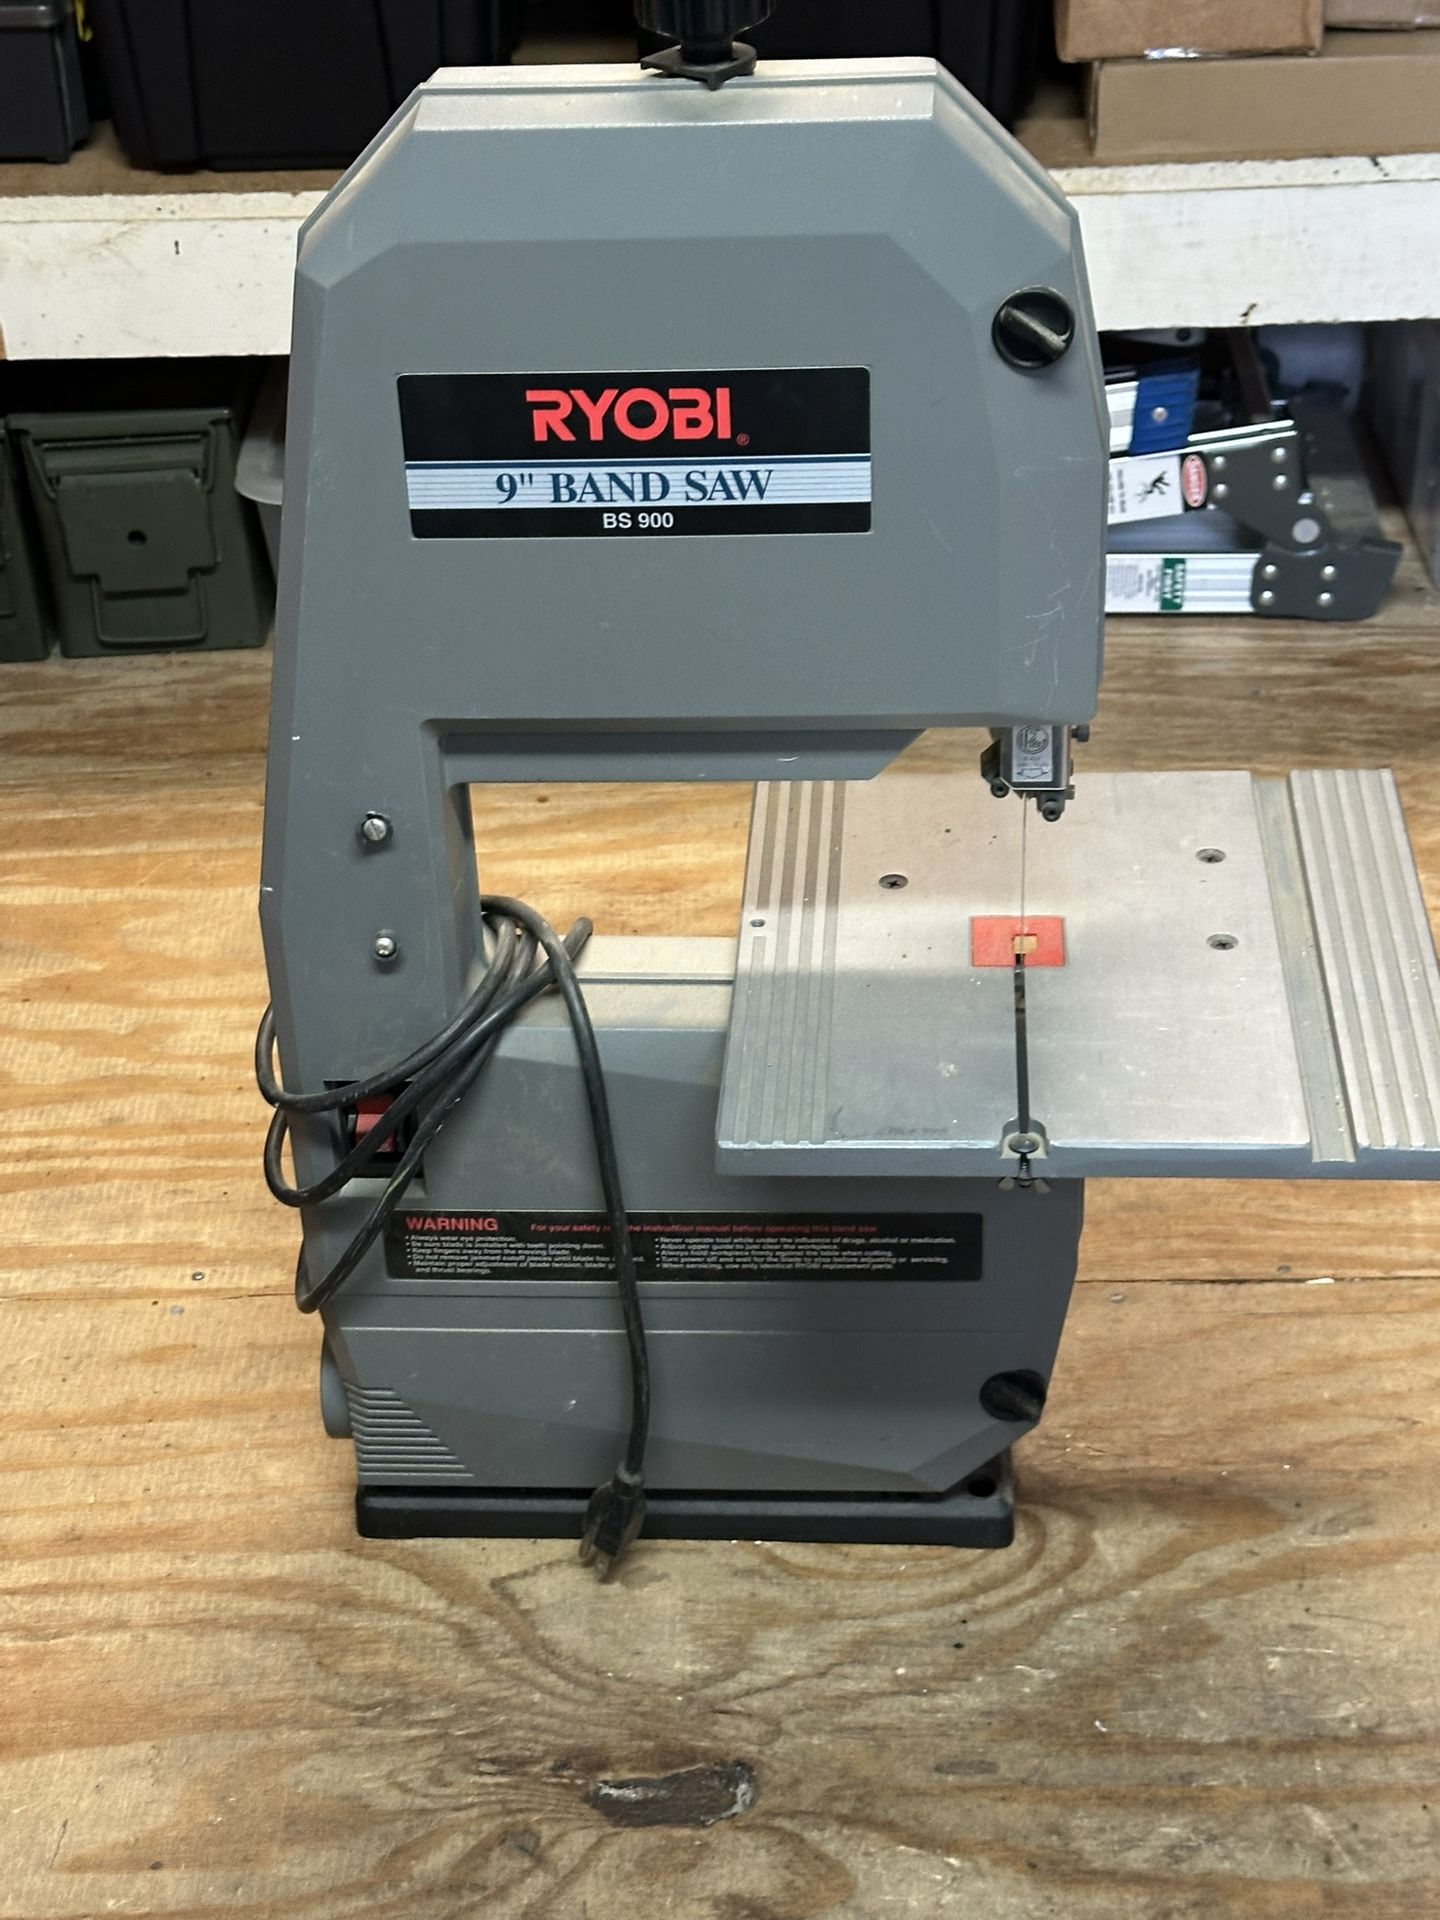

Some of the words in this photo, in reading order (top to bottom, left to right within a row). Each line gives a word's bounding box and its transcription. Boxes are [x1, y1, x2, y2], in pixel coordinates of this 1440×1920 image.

[525, 387, 731, 442] RYOBI
[495, 473, 534, 504] 9"
[550, 472, 670, 504] BAND
[684, 469, 773, 502] SAW
[602, 512, 632, 529] BS
[638, 511, 674, 529] 900
[406, 1218, 498, 1231] WARNING
